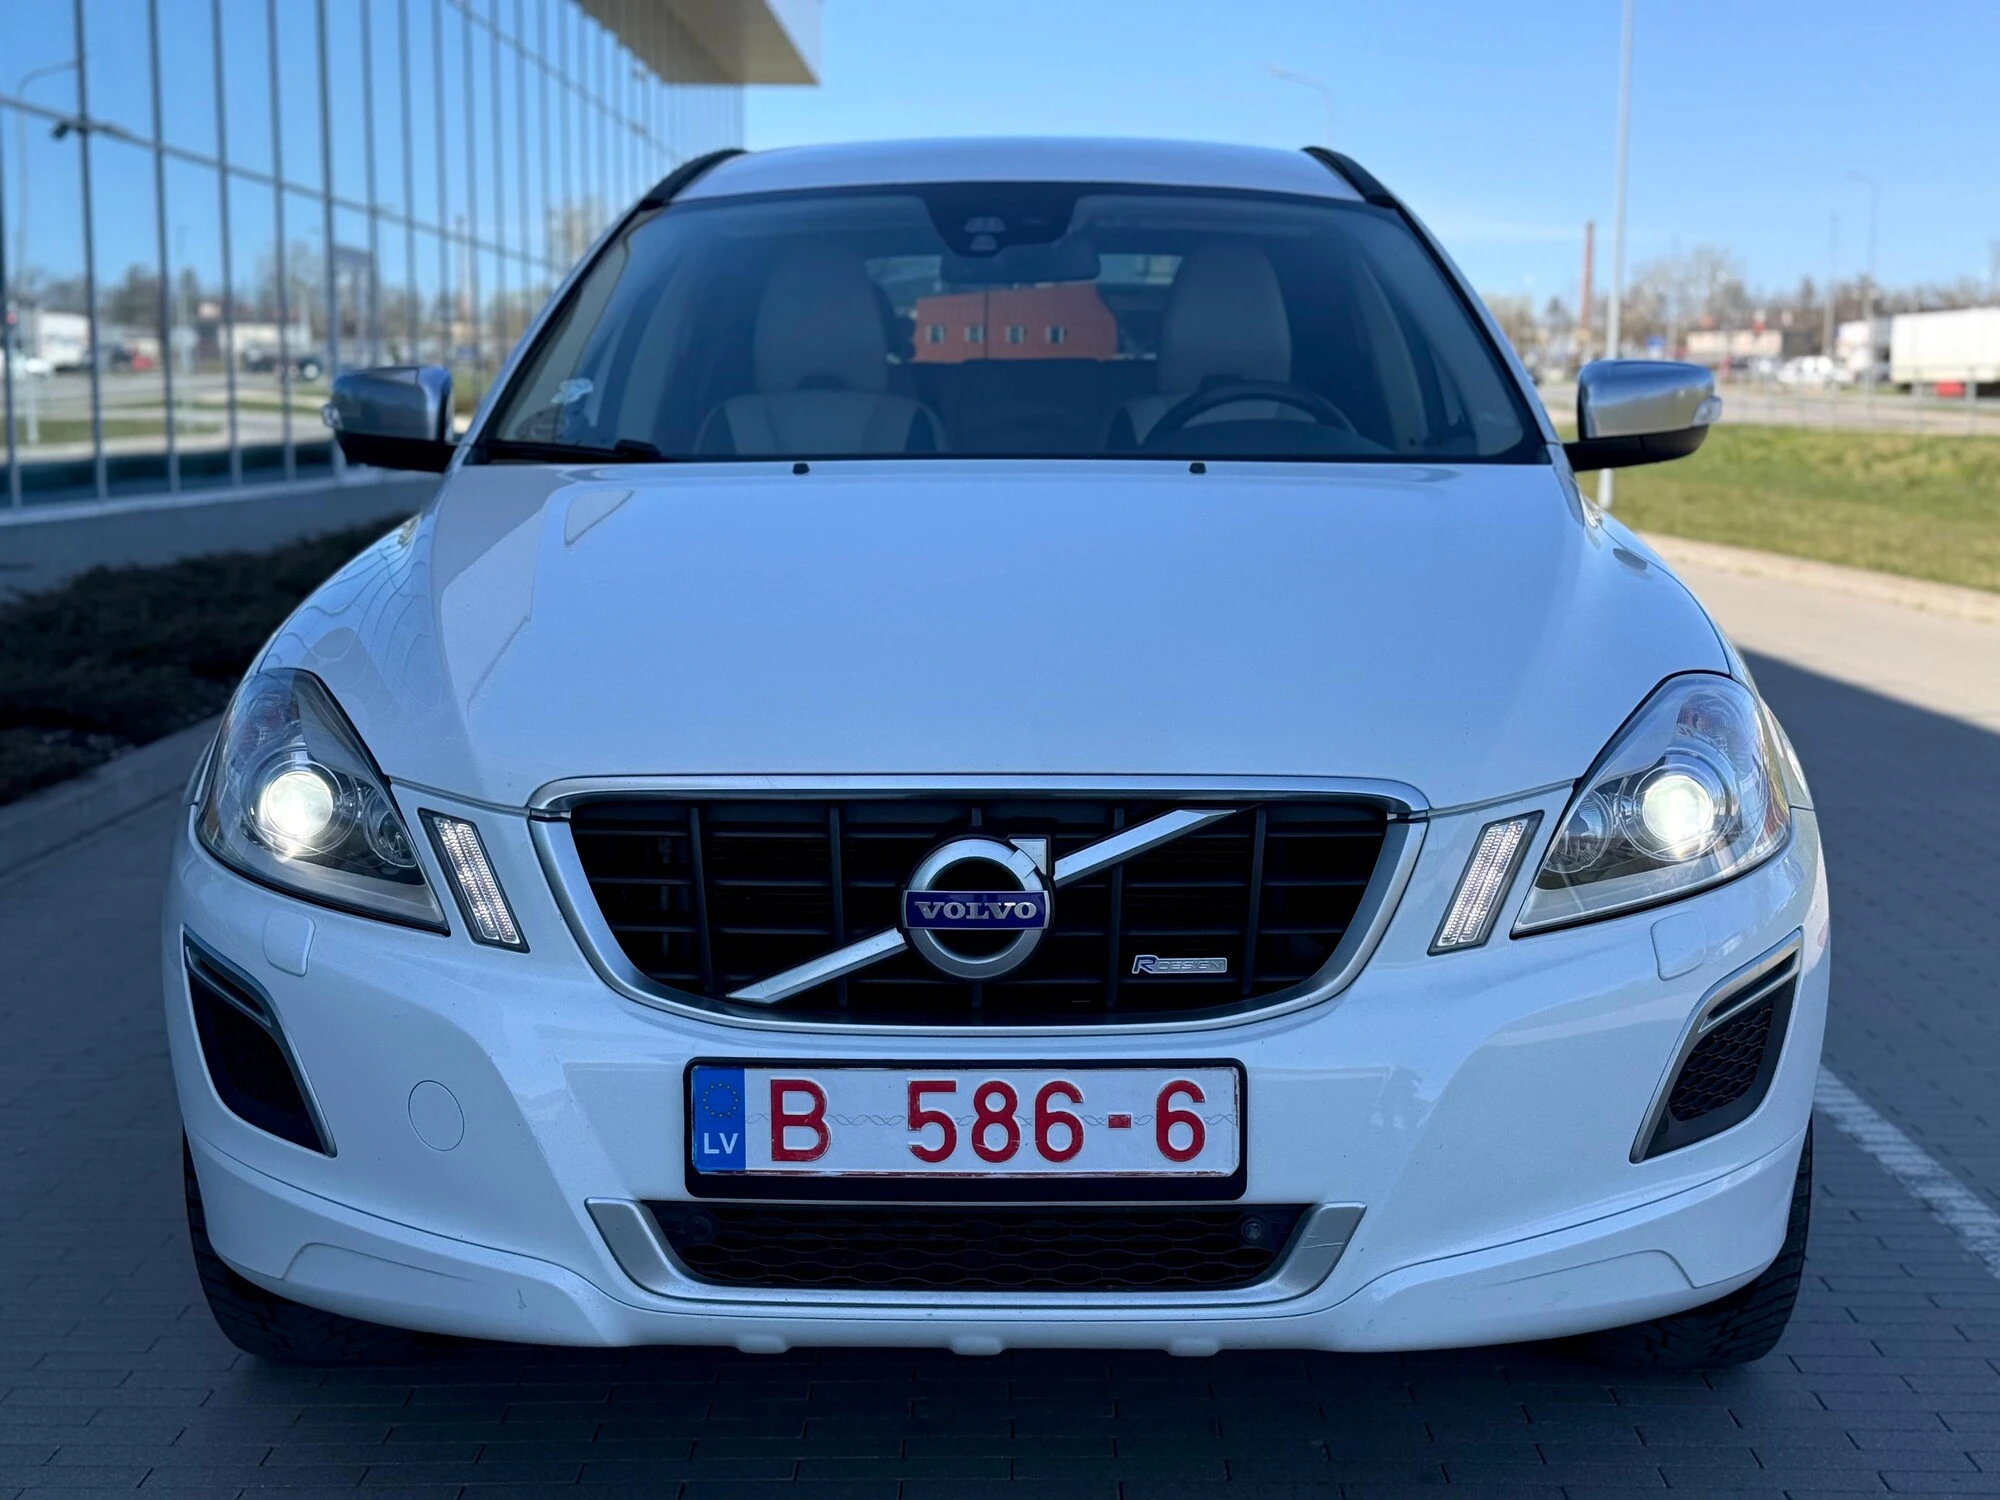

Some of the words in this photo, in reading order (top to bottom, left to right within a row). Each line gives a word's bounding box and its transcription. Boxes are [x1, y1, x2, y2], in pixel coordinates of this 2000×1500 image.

[914, 901, 1037, 919] VOLVO
[770, 1079, 831, 1162] B
[907, 1079, 1206, 1163] 586-6
[703, 1132, 739, 1155] LV
